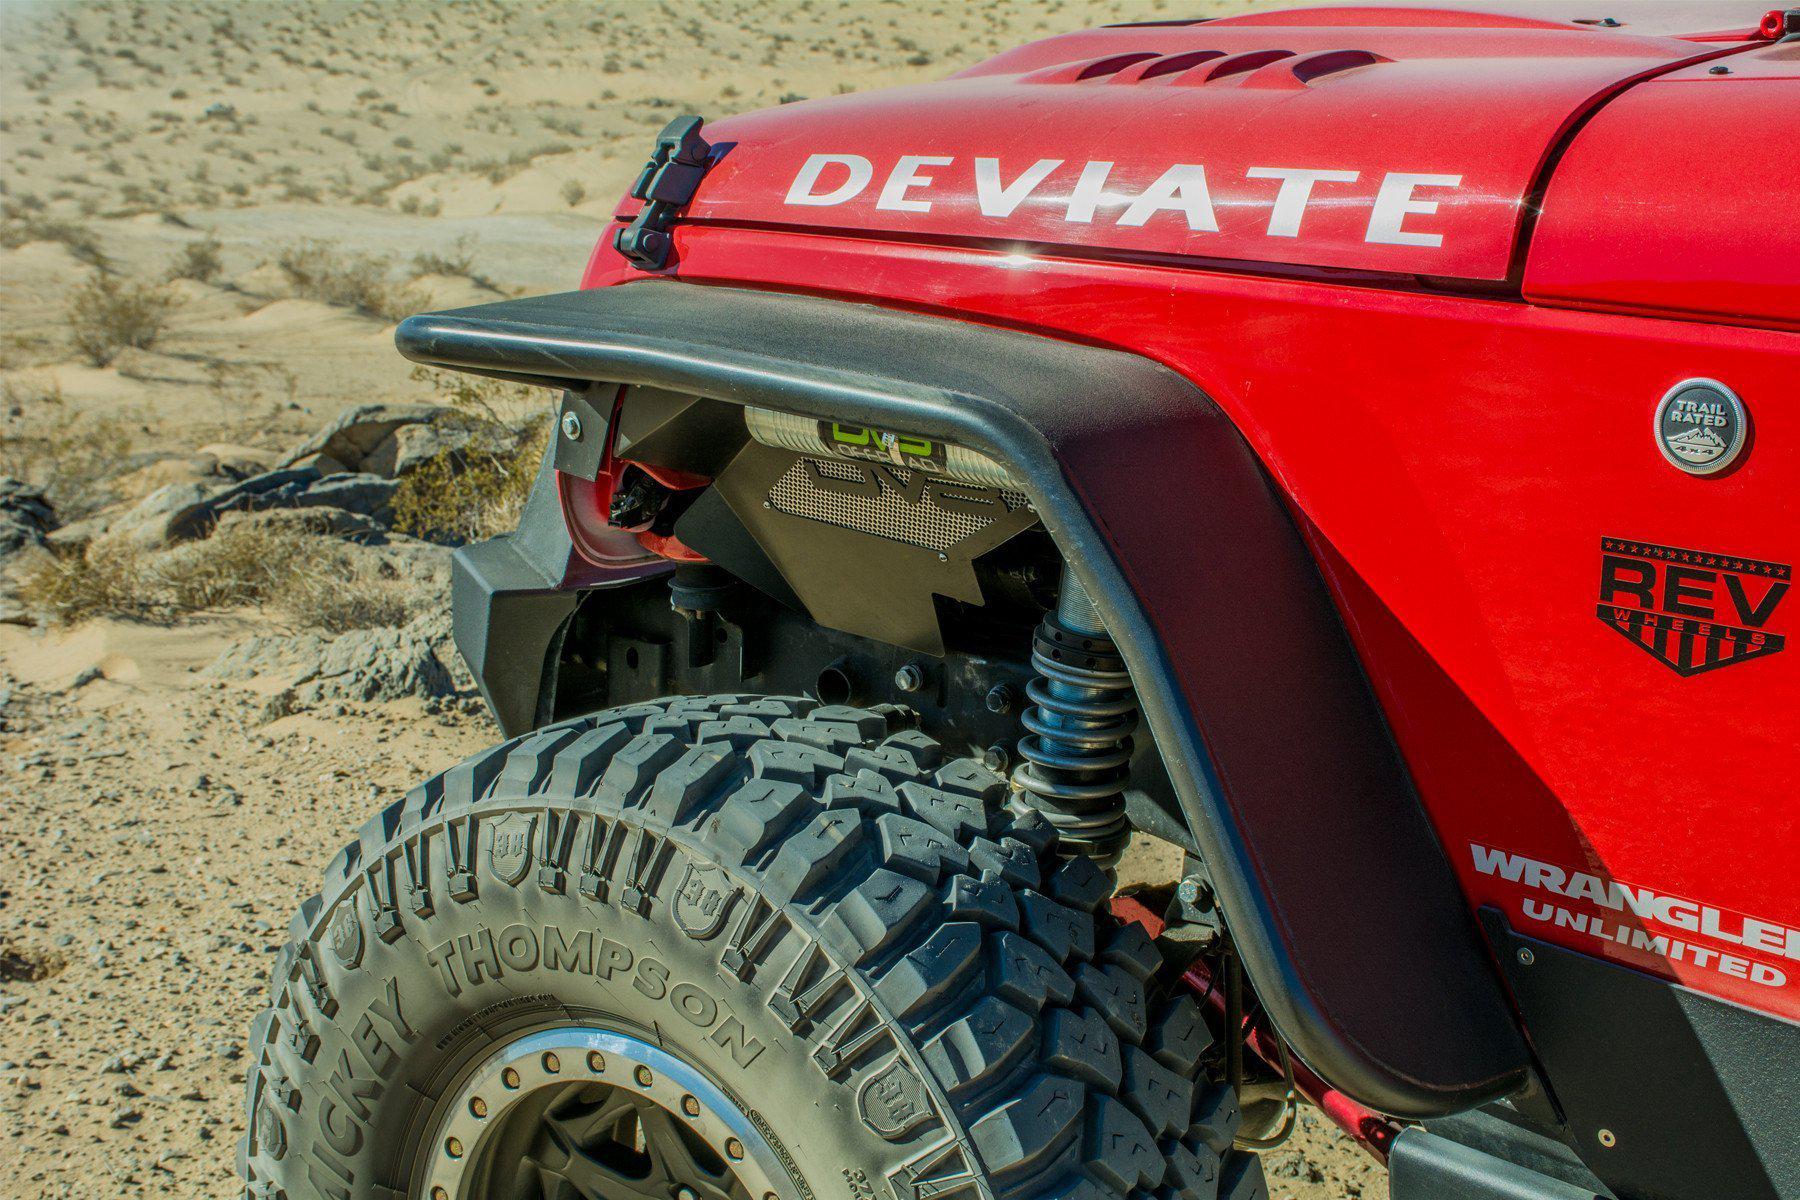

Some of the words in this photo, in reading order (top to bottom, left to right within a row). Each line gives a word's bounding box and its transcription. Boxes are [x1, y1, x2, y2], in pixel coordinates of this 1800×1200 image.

[783, 153, 1463, 248] DEVIATE
[1671, 411, 1727, 427] RATED
[1677, 400, 1726, 416] TRAIL
[1600, 553, 1791, 628] REV
[1613, 608, 1767, 646] WHEELS
[1521, 898, 1787, 988] UNLIMITED
[426, 922, 767, 1070] THOMPSON
